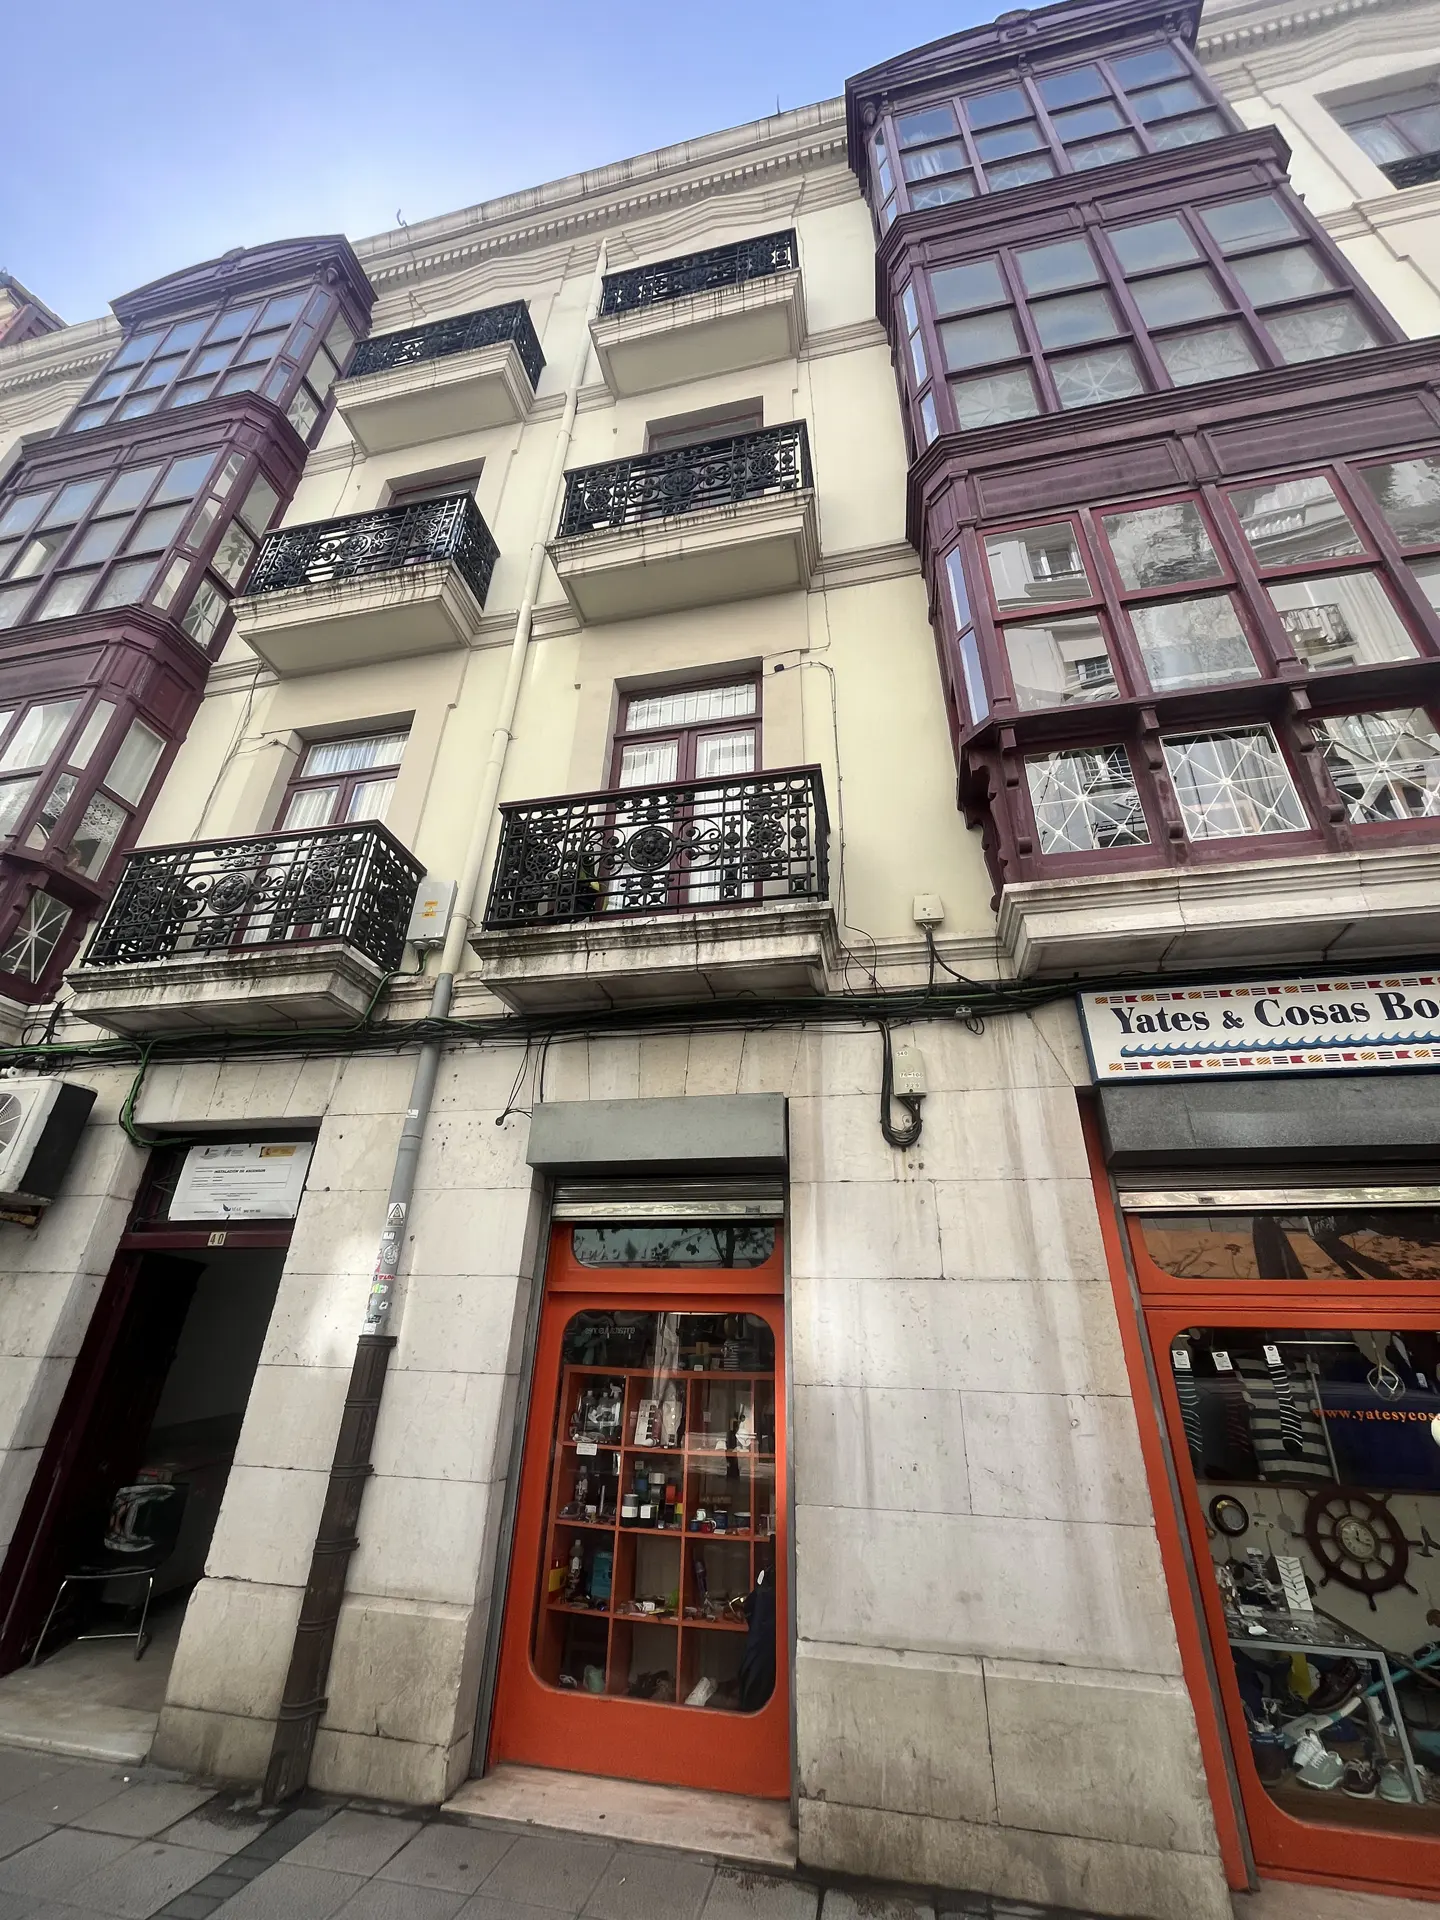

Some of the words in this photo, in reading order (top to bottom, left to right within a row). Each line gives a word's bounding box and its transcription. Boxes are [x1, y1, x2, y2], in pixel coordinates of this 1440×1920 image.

[1110, 1006, 1210, 1034] Yates
[1222, 1010, 1245, 1030] &
[1253, 998, 1371, 1028] Cosas
[1374, 992, 1440, 1021] Bo
[209, 1233, 225, 1245] 40
